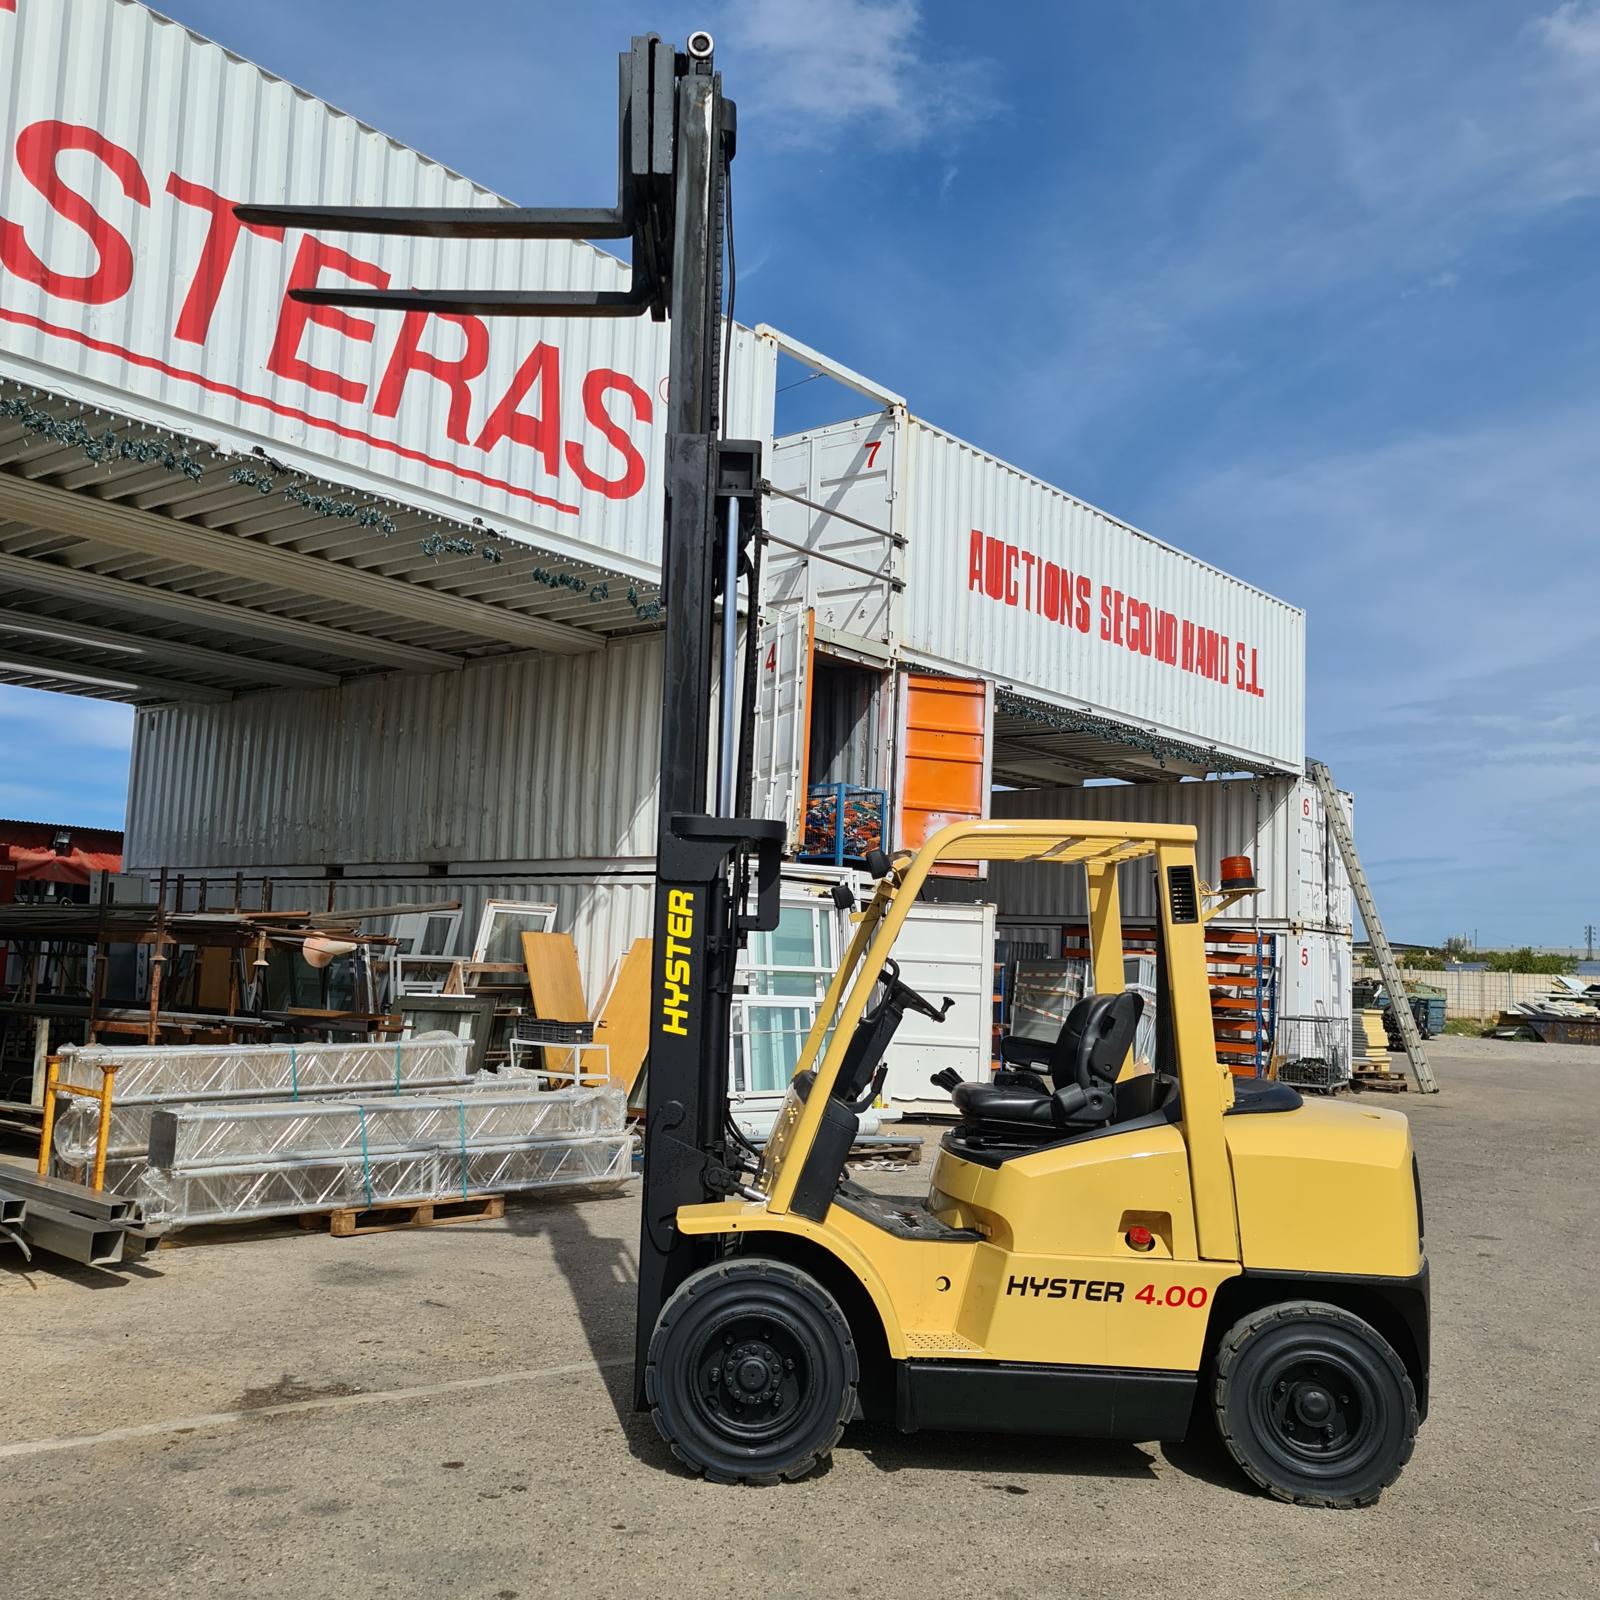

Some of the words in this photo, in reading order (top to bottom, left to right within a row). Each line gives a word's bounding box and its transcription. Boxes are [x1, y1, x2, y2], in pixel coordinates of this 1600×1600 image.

[864, 441, 882, 468] 7
[968, 529, 1092, 634] AUCTIONS
[1100, 585, 1178, 668] SECOND
[1181, 619, 1230, 685] HAND
[765, 642, 777, 673] 4
[1302, 798, 1310, 816] 6
[662, 889, 694, 1036] HYSTER
[1300, 948, 1309, 966] 5
[1006, 1275, 1125, 1303] HYSTER
[1134, 1284, 1208, 1309] 4.00
